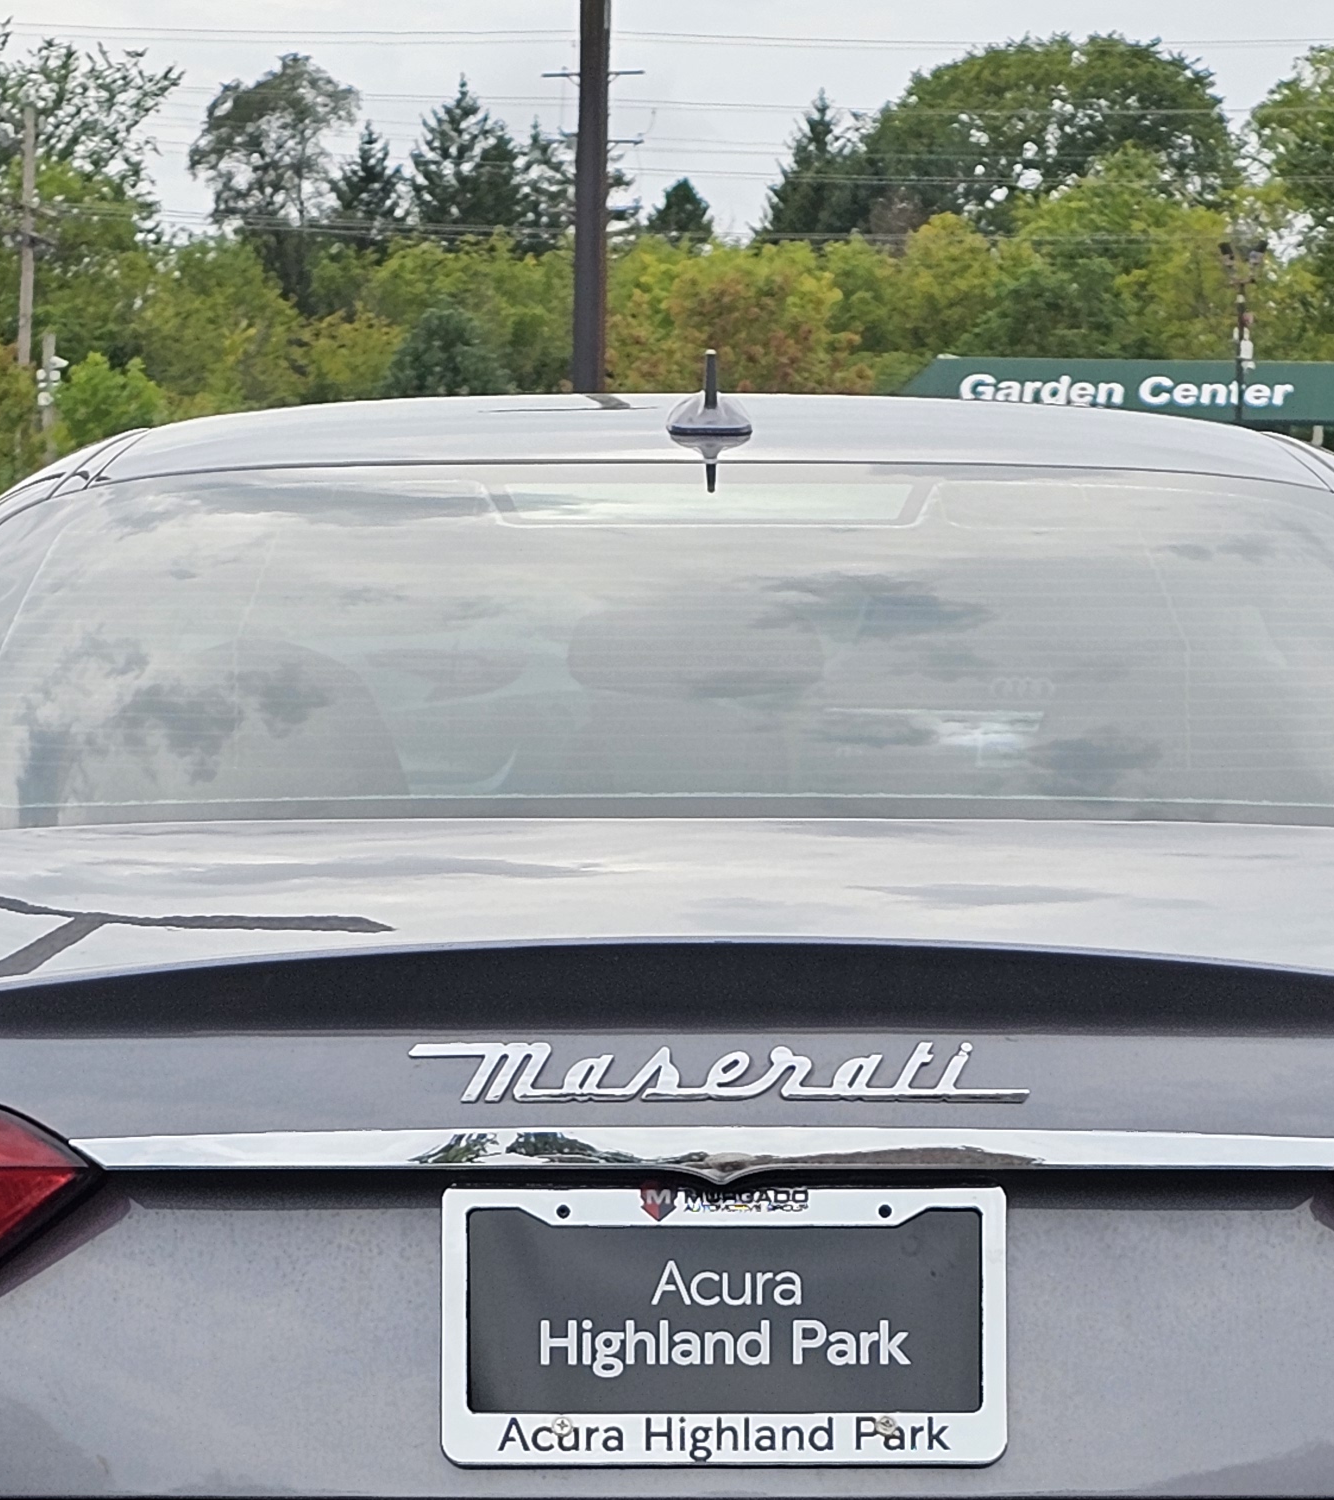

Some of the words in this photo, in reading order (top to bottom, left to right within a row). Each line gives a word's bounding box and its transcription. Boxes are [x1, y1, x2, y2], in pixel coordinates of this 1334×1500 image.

[959, 373, 1125, 405] Garden
[1138, 375, 1295, 407] Center
[408, 1041, 1032, 1103] Maserati
[650, 1259, 804, 1307] Acura
[538, 1319, 771, 1379] Highland
[791, 1319, 912, 1366] Park
[497, 1416, 625, 1453] Acura
[643, 1415, 835, 1462] Highland
[854, 1415, 953, 1453] Park
